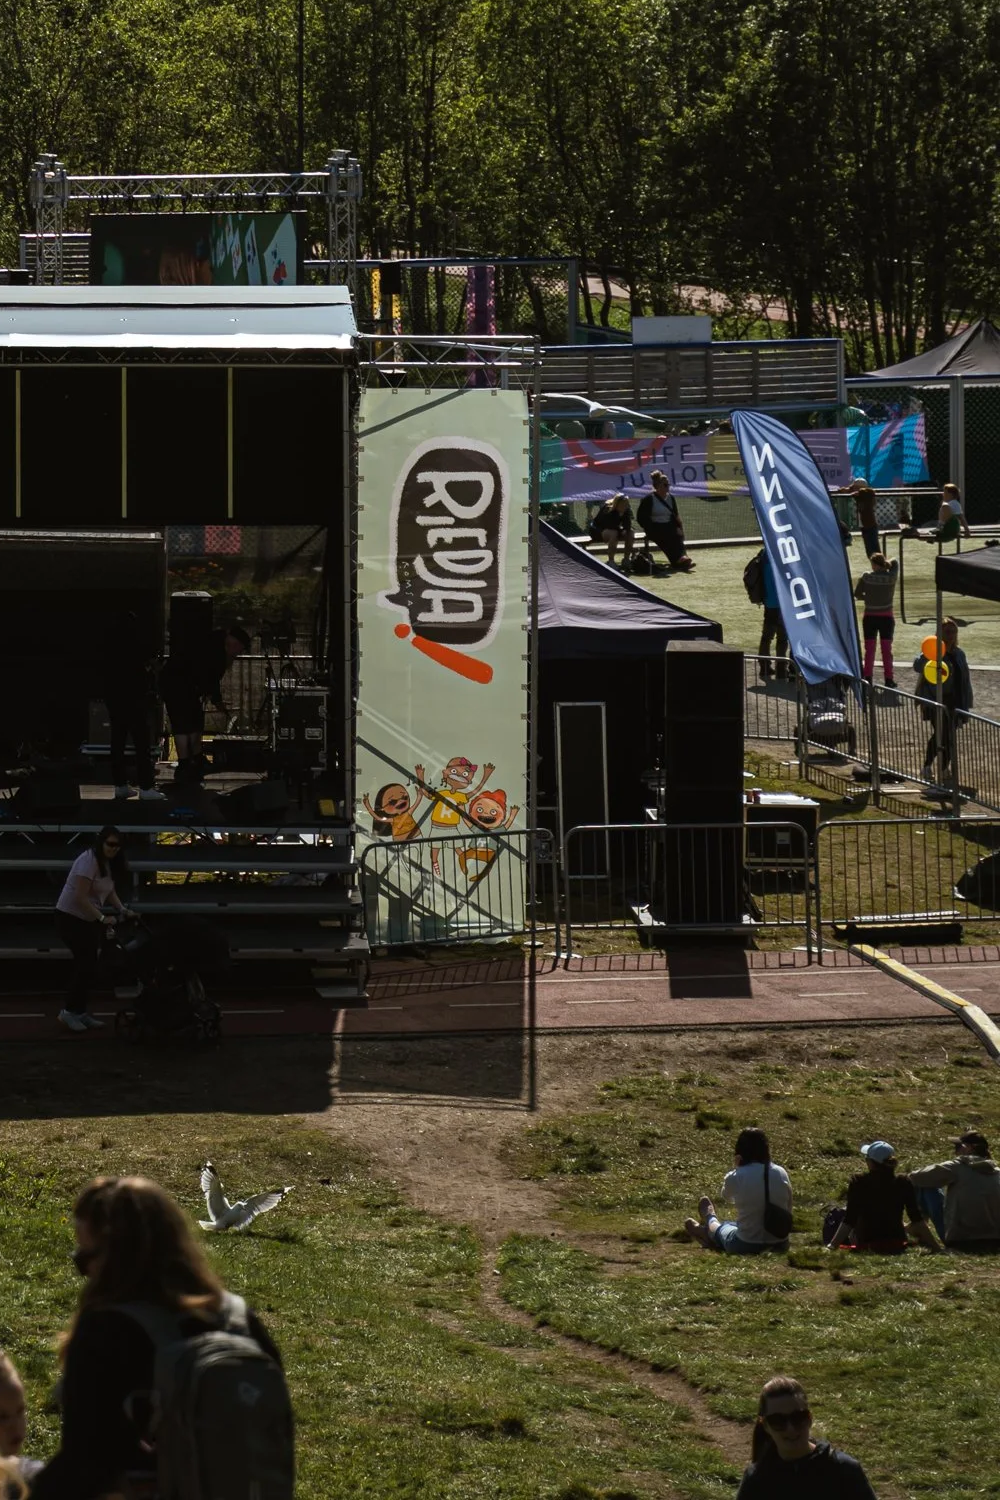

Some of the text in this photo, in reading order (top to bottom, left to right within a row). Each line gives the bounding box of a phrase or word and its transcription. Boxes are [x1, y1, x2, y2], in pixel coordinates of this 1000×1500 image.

[632, 443, 692, 467] TIFF
[615, 463, 718, 490] JUIOR
[401, 561, 413, 607] ROMSA
